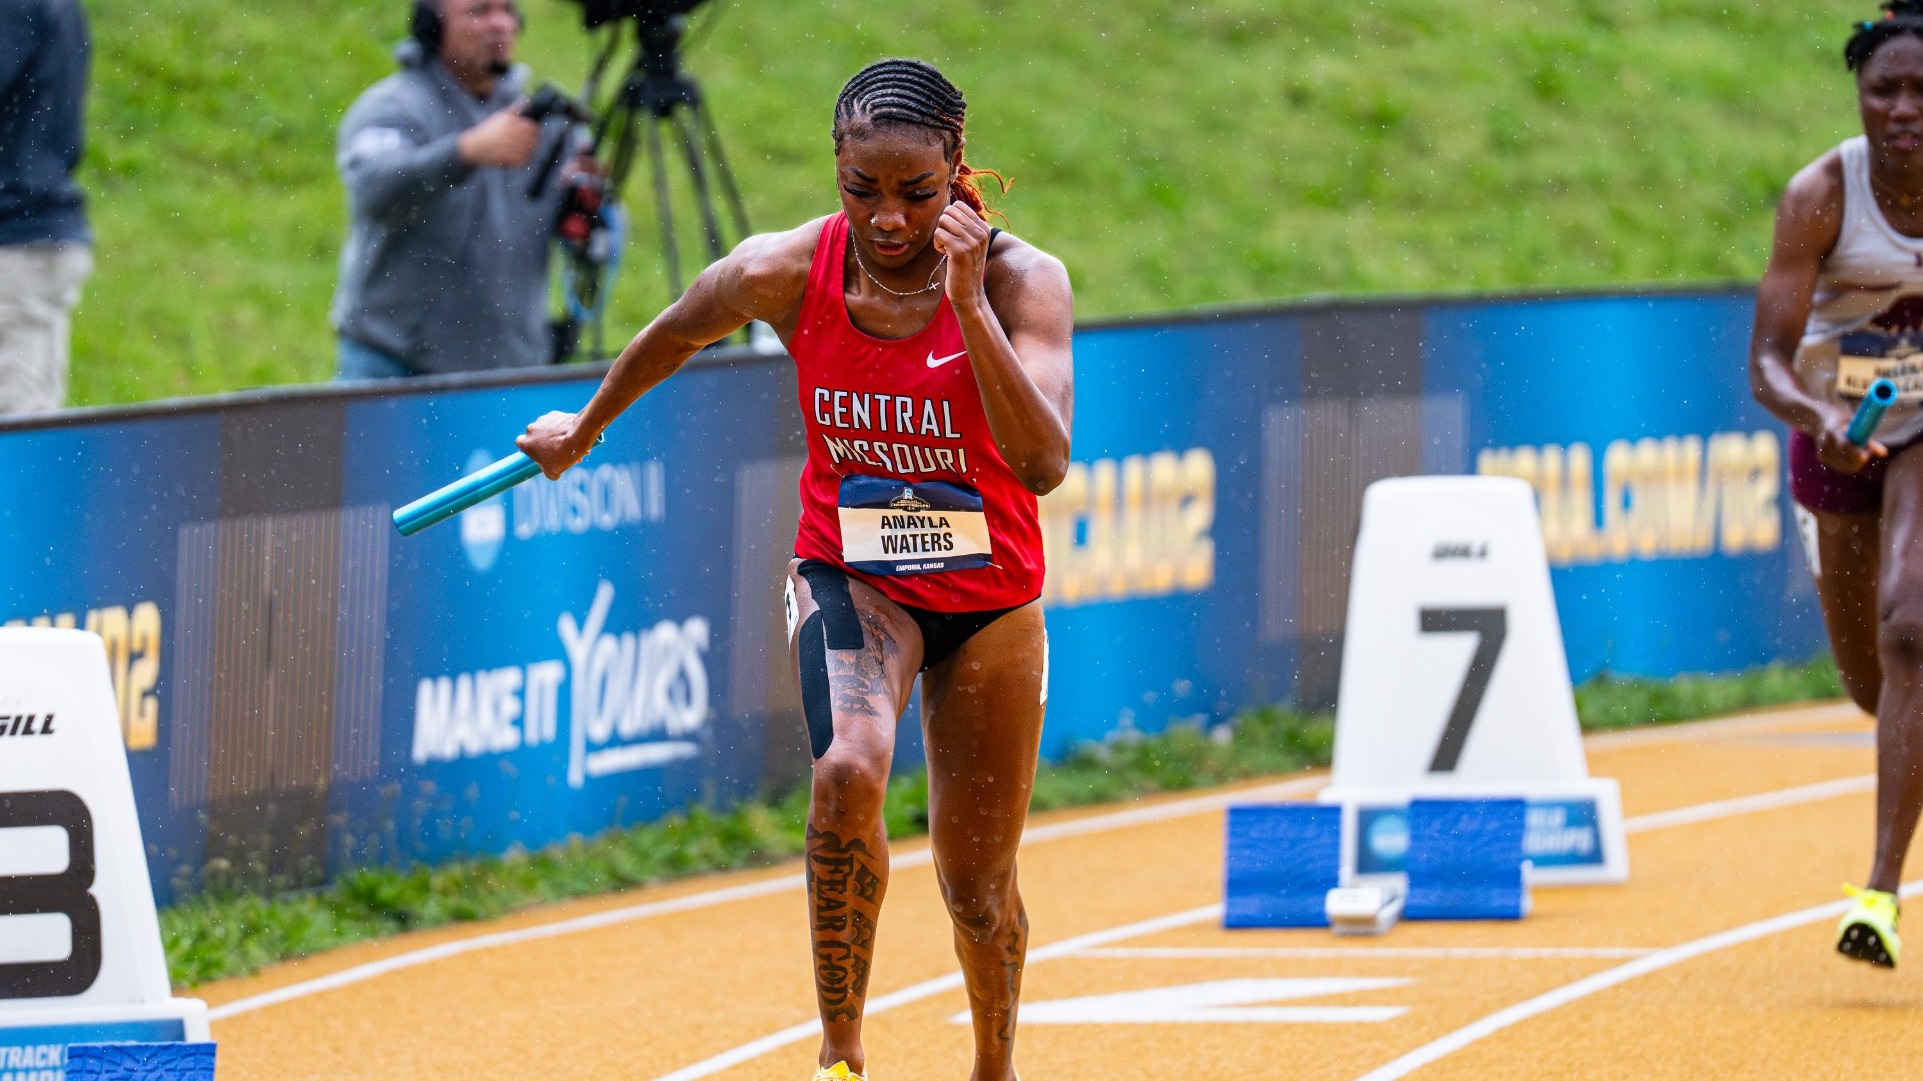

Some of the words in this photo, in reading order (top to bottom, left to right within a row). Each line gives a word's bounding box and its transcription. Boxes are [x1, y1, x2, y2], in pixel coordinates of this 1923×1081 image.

[813, 387, 962, 440] CENTRAL
[880, 514, 951, 530] ANAYLA
[880, 531, 954, 555] WATERS
[896, 563, 922, 572] EMPORIA,
[922, 562, 945, 570] KANSAS
[412, 666, 523, 765] MAKE
[524, 659, 566, 748] IT
[556, 578, 711, 789] YOURS
[1418, 605, 1508, 775] 7
[811, 852, 855, 933] FEAR
